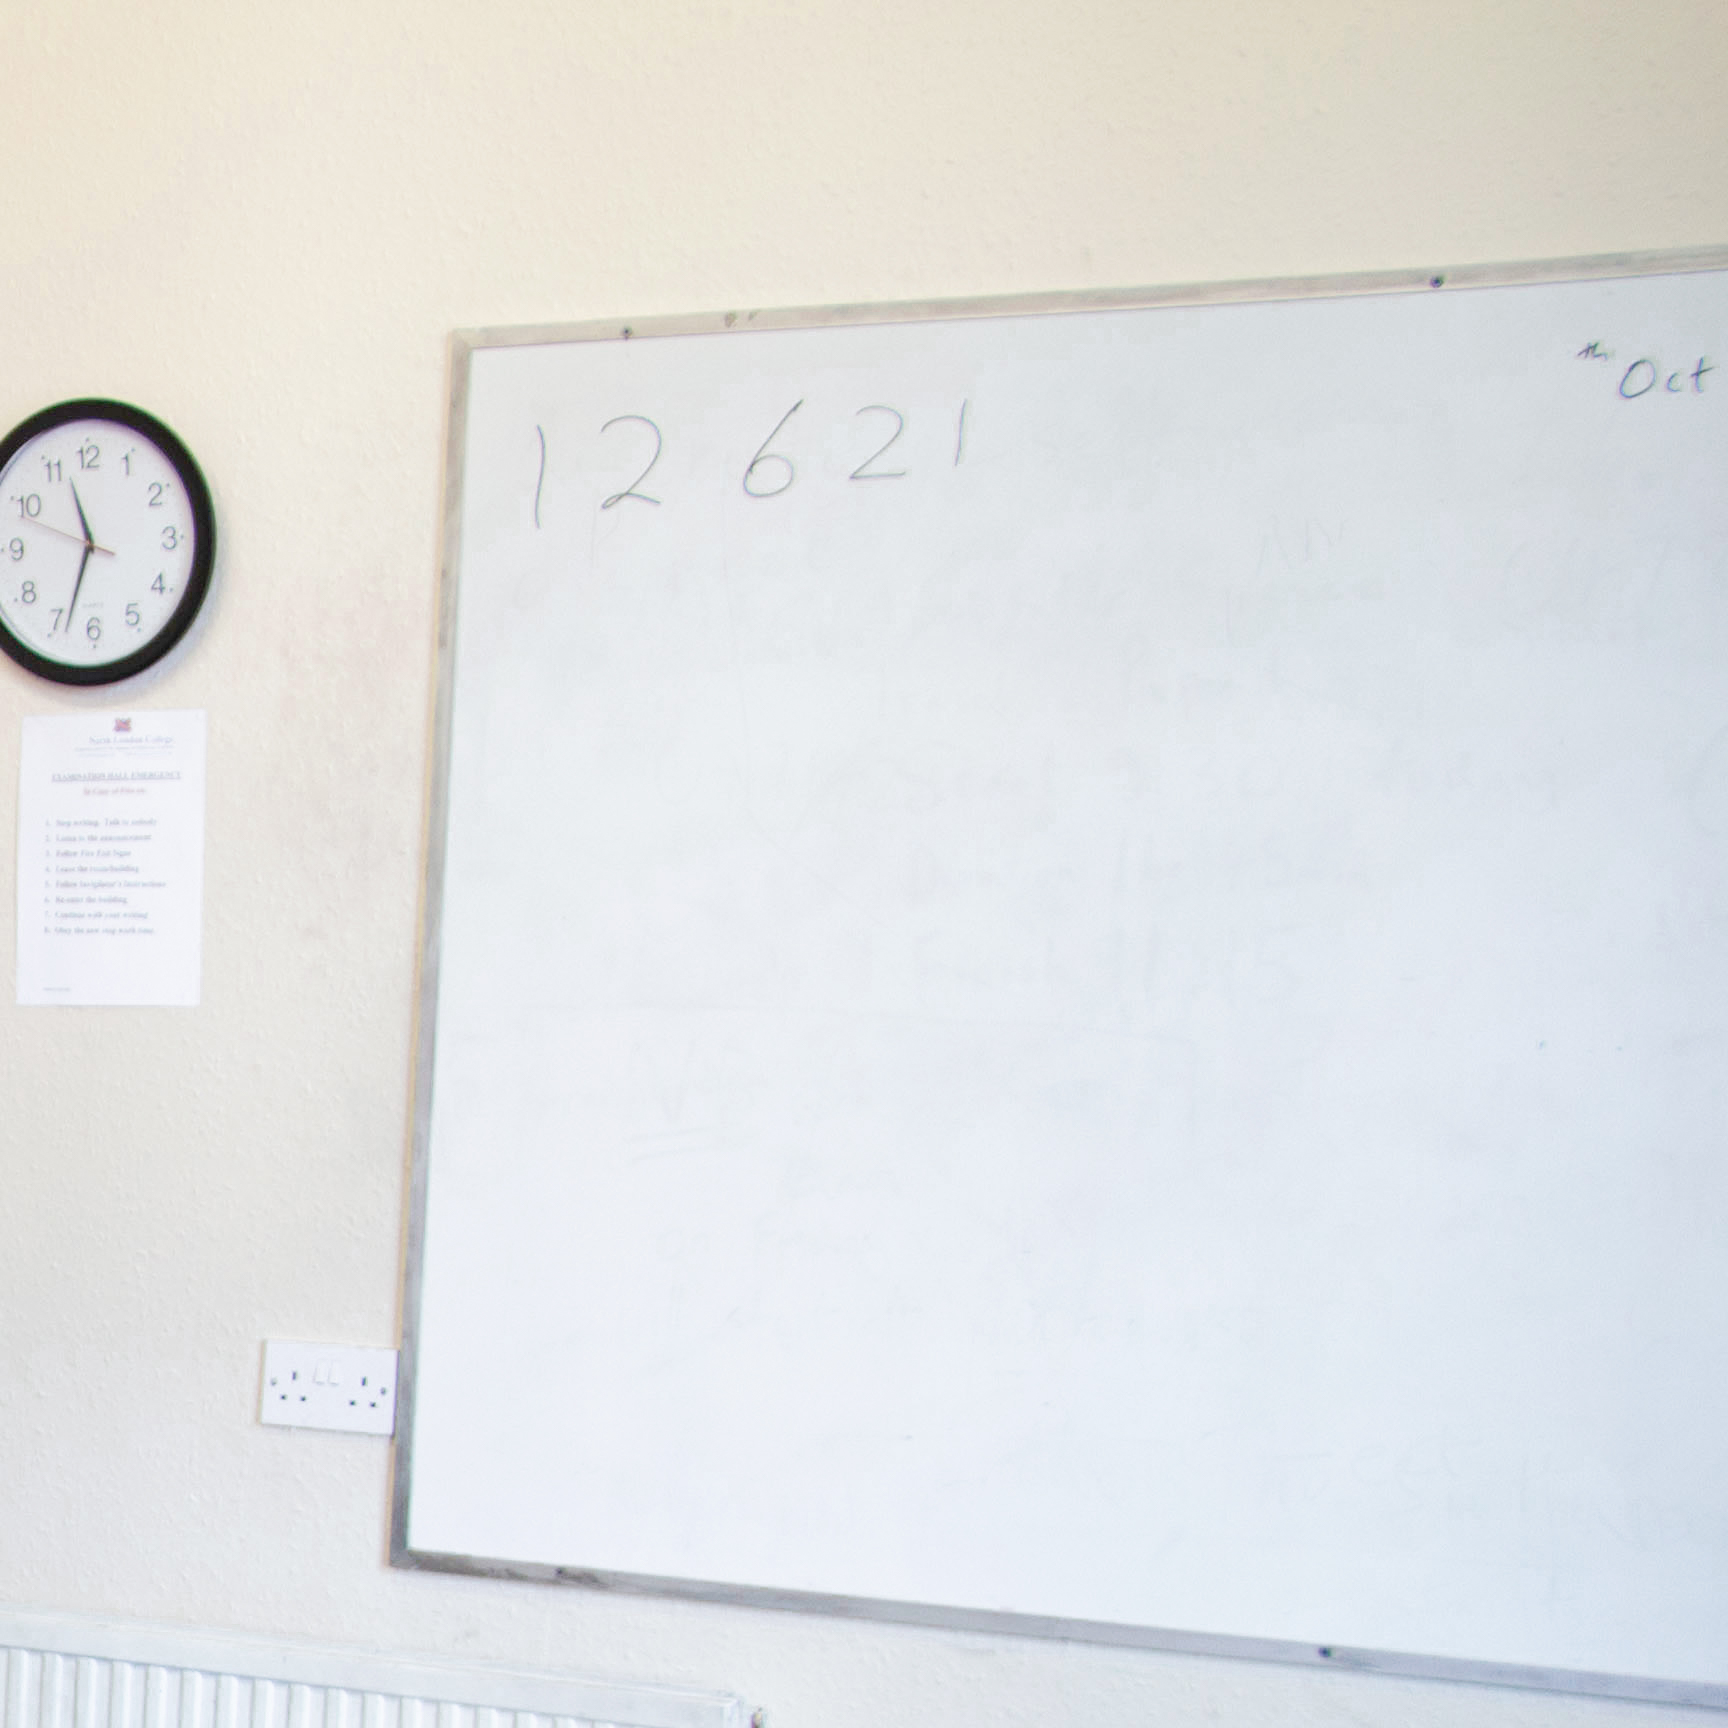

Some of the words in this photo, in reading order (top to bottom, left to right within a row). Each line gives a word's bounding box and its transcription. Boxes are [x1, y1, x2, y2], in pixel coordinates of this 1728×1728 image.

[1617, 356, 1716, 400] Oct
[76, 445, 101, 470] 12
[121, 454, 132, 477] 1
[43, 459, 63, 483] 11
[16, 493, 43, 518] 10
[147, 481, 165, 507] 2
[8, 537, 25, 561] 9
[161, 526, 178, 551] 3
[20, 580, 38, 604] 8
[151, 572, 167, 595] 4
[50, 608, 64, 632] 7
[125, 602, 141, 627] 5
[86, 617, 102, 641] 6
